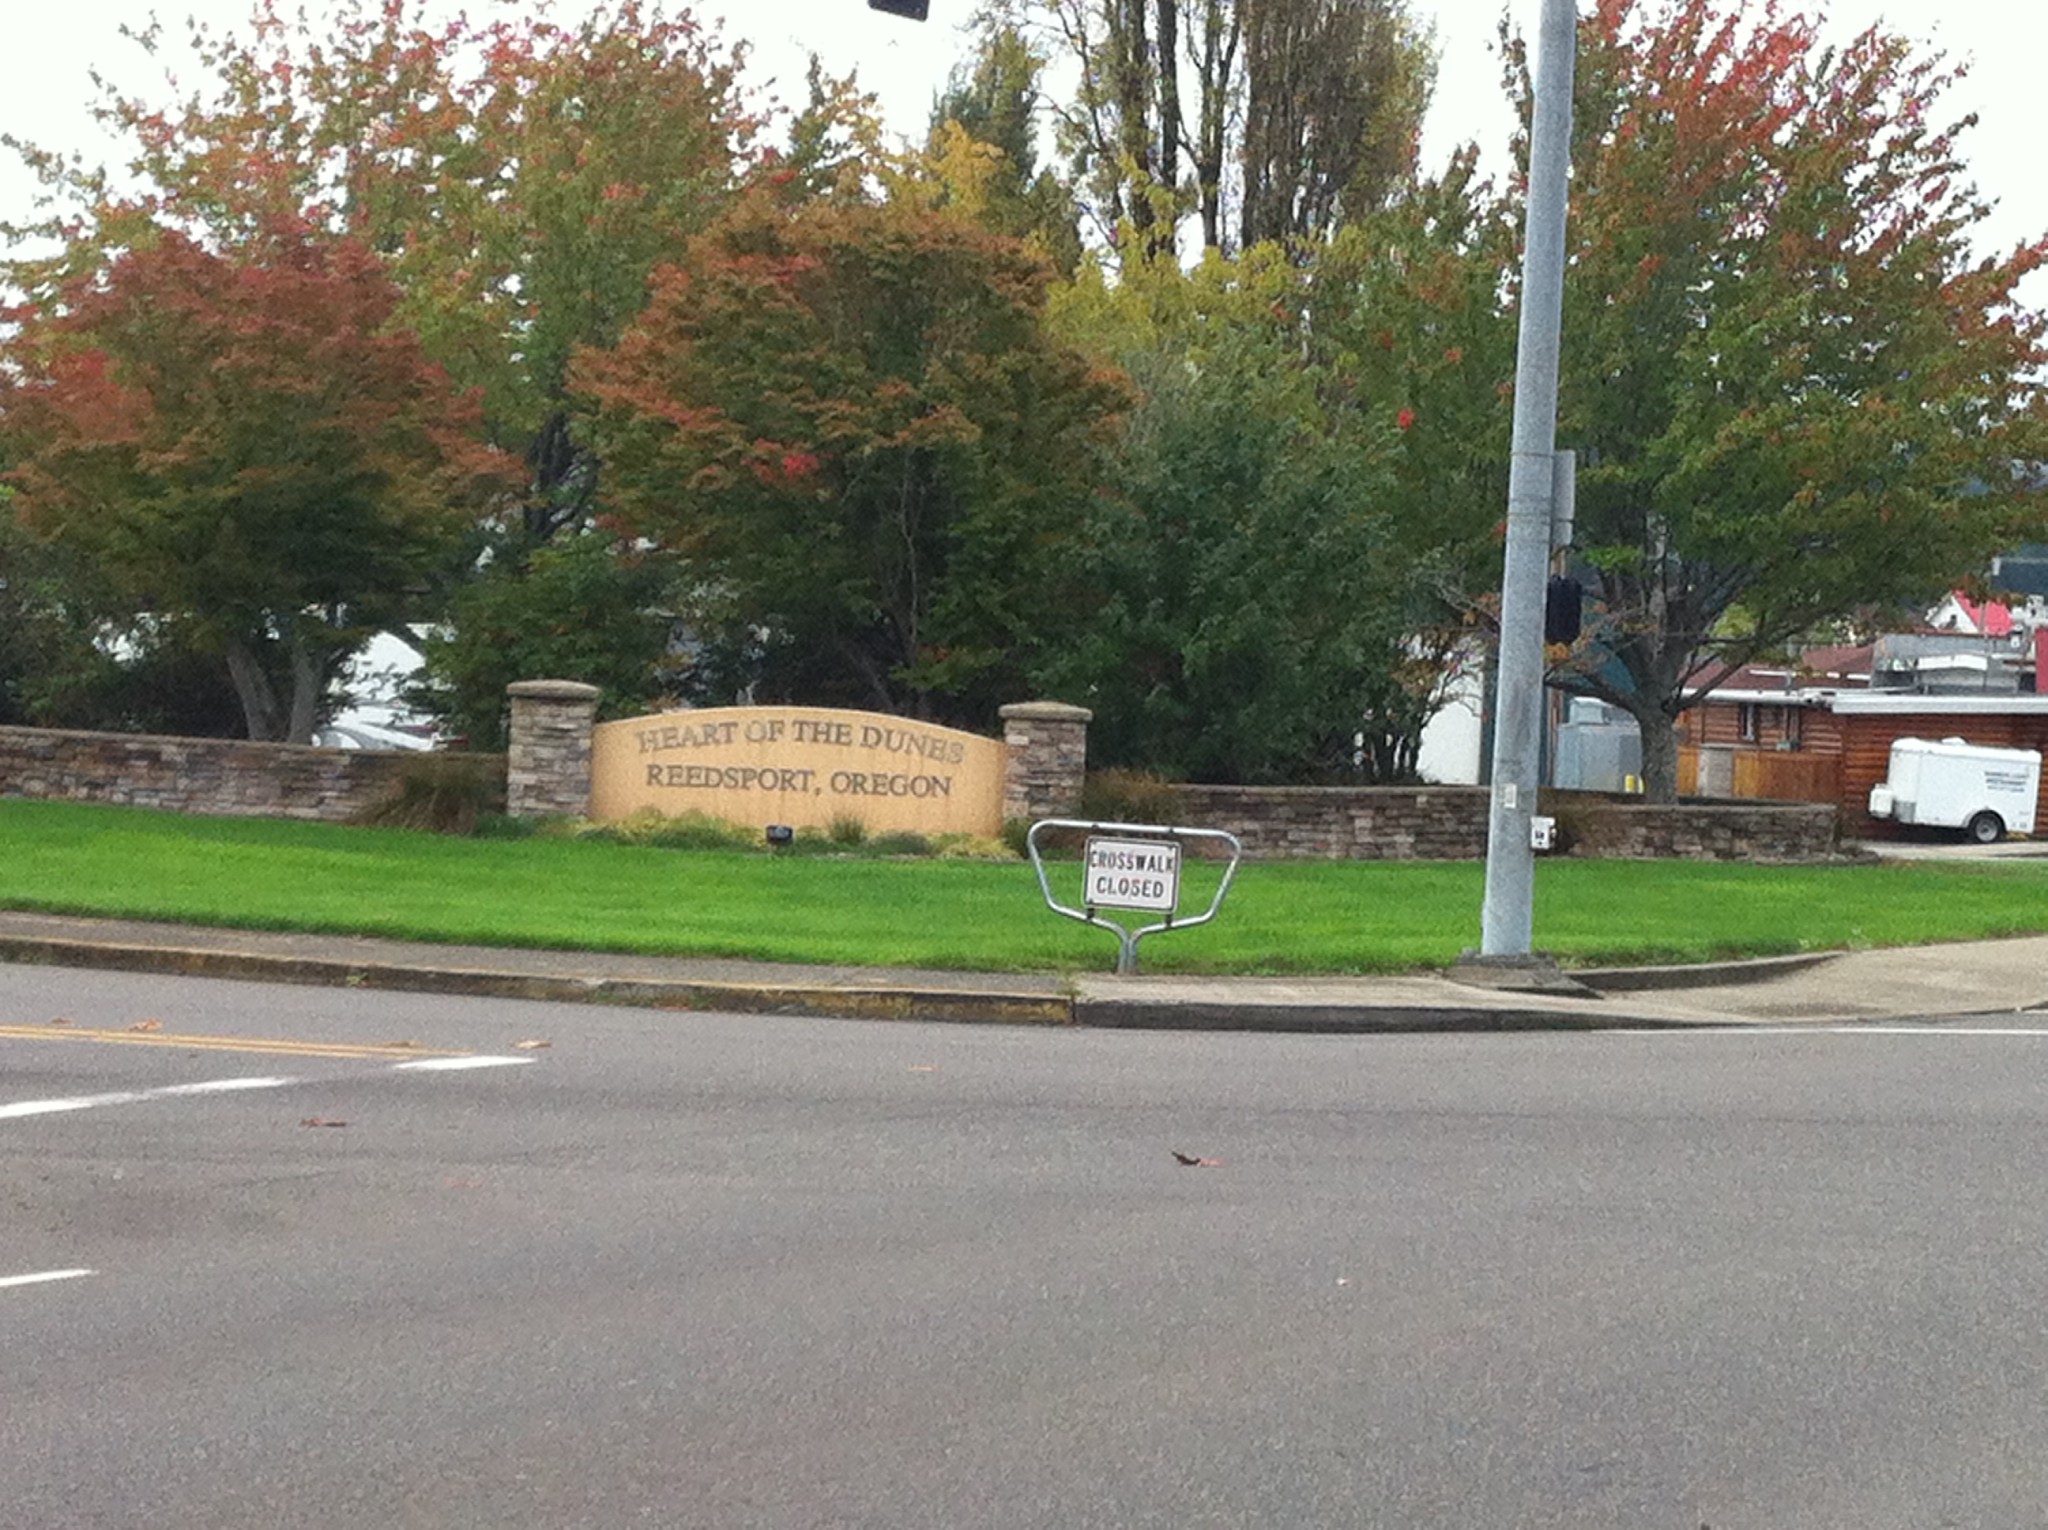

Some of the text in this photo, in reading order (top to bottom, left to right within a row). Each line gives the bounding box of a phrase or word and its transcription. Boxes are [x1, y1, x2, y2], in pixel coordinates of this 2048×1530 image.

[638, 720, 965, 764] HEART OF THE DUNES
[646, 764, 952, 798] REEDSPORT, OREGON
[1090, 850, 1173, 873] CROSSWALK
[1097, 876, 1164, 898] CLOSED
